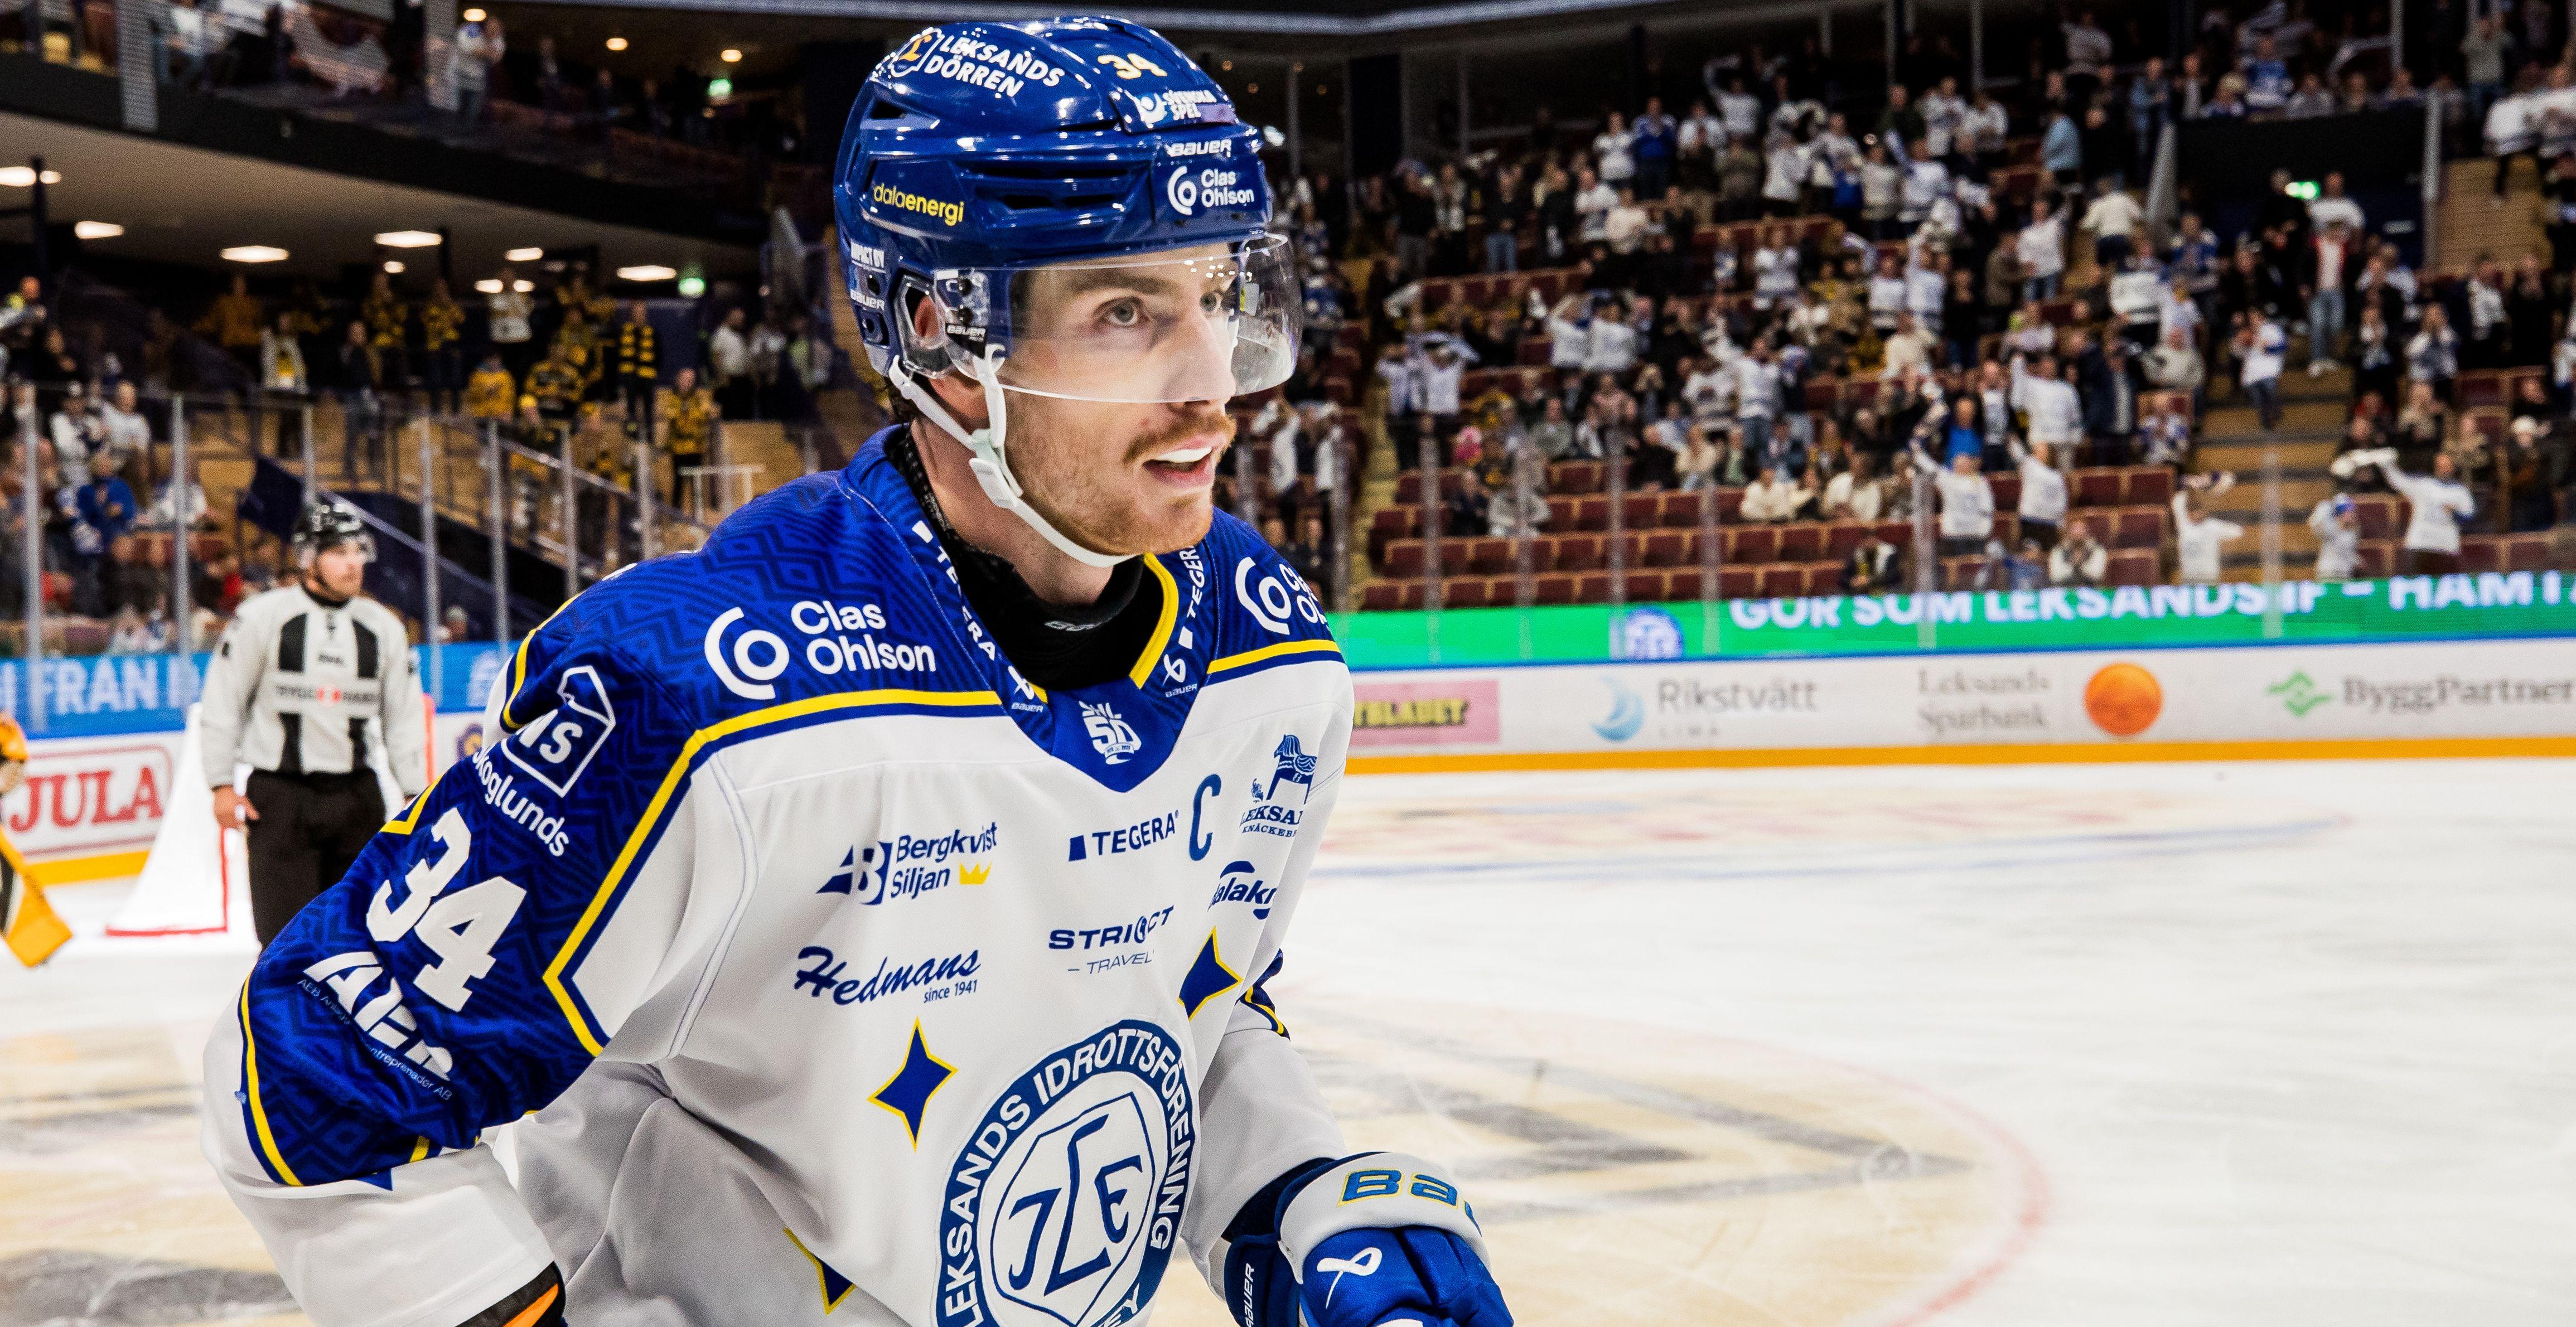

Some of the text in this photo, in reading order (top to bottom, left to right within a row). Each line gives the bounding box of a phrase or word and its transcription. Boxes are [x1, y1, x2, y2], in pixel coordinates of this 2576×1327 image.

[924, 54, 1024, 97] DÖRREN
[939, 35, 1065, 86] LEKSANDS
[1097, 53, 1167, 79] 34
[1170, 103, 1201, 120] SPEL
[1201, 168, 1236, 188] Clas
[1201, 188, 1254, 207] Ohlson
[873, 182, 965, 226] dalaenergi
[1180, 545, 1205, 618] TEGER
[791, 600, 886, 635] Clas
[806, 636, 936, 675] Ohlson
[10, 764, 162, 833] JULA
[1188, 773, 1221, 861] C
[896, 821, 997, 864] Bergkvist
[891, 868, 950, 899] Siljan
[366, 807, 527, 1012] 34
[794, 945, 981, 1005] Hedmans
[1087, 951, 1152, 975] TRAVEL
[924, 979, 978, 1003] since 1941
[945, 1029, 1191, 1327] LEKSANDS IDROTTSFÖRENING
